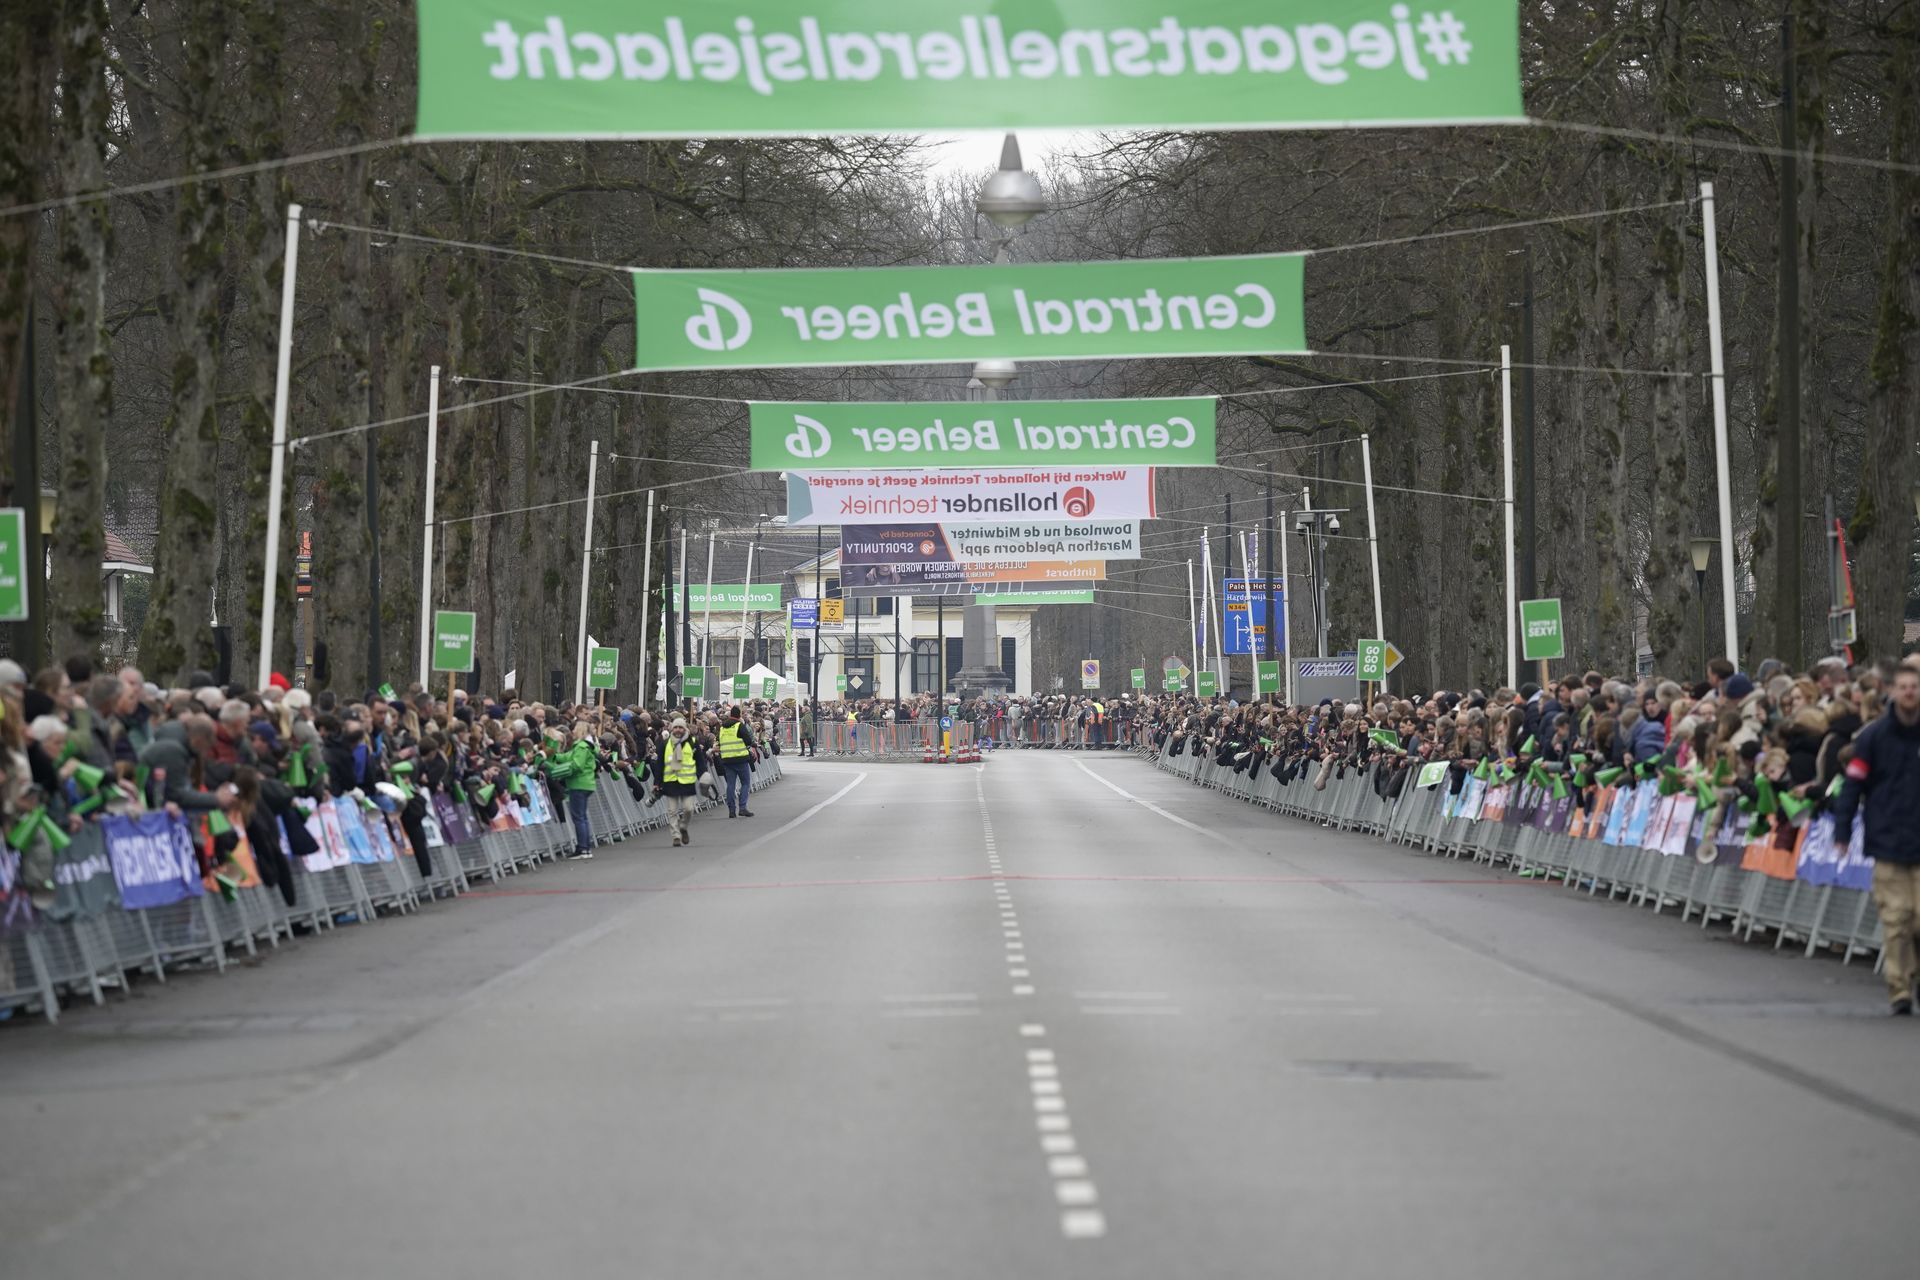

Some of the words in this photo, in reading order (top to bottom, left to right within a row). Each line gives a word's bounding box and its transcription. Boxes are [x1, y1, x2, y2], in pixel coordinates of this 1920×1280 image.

[1226, 593, 1266, 601] Hardwijk
[1528, 627, 1557, 637] SEXY!
[1366, 646, 1380, 655] GO
[1364, 655, 1379, 664] GO
[596, 660, 611, 668] GAS
[593, 667, 614, 675] EROP!
[1363, 664, 1377, 673] GO
[1261, 672, 1277, 680] HUP!
